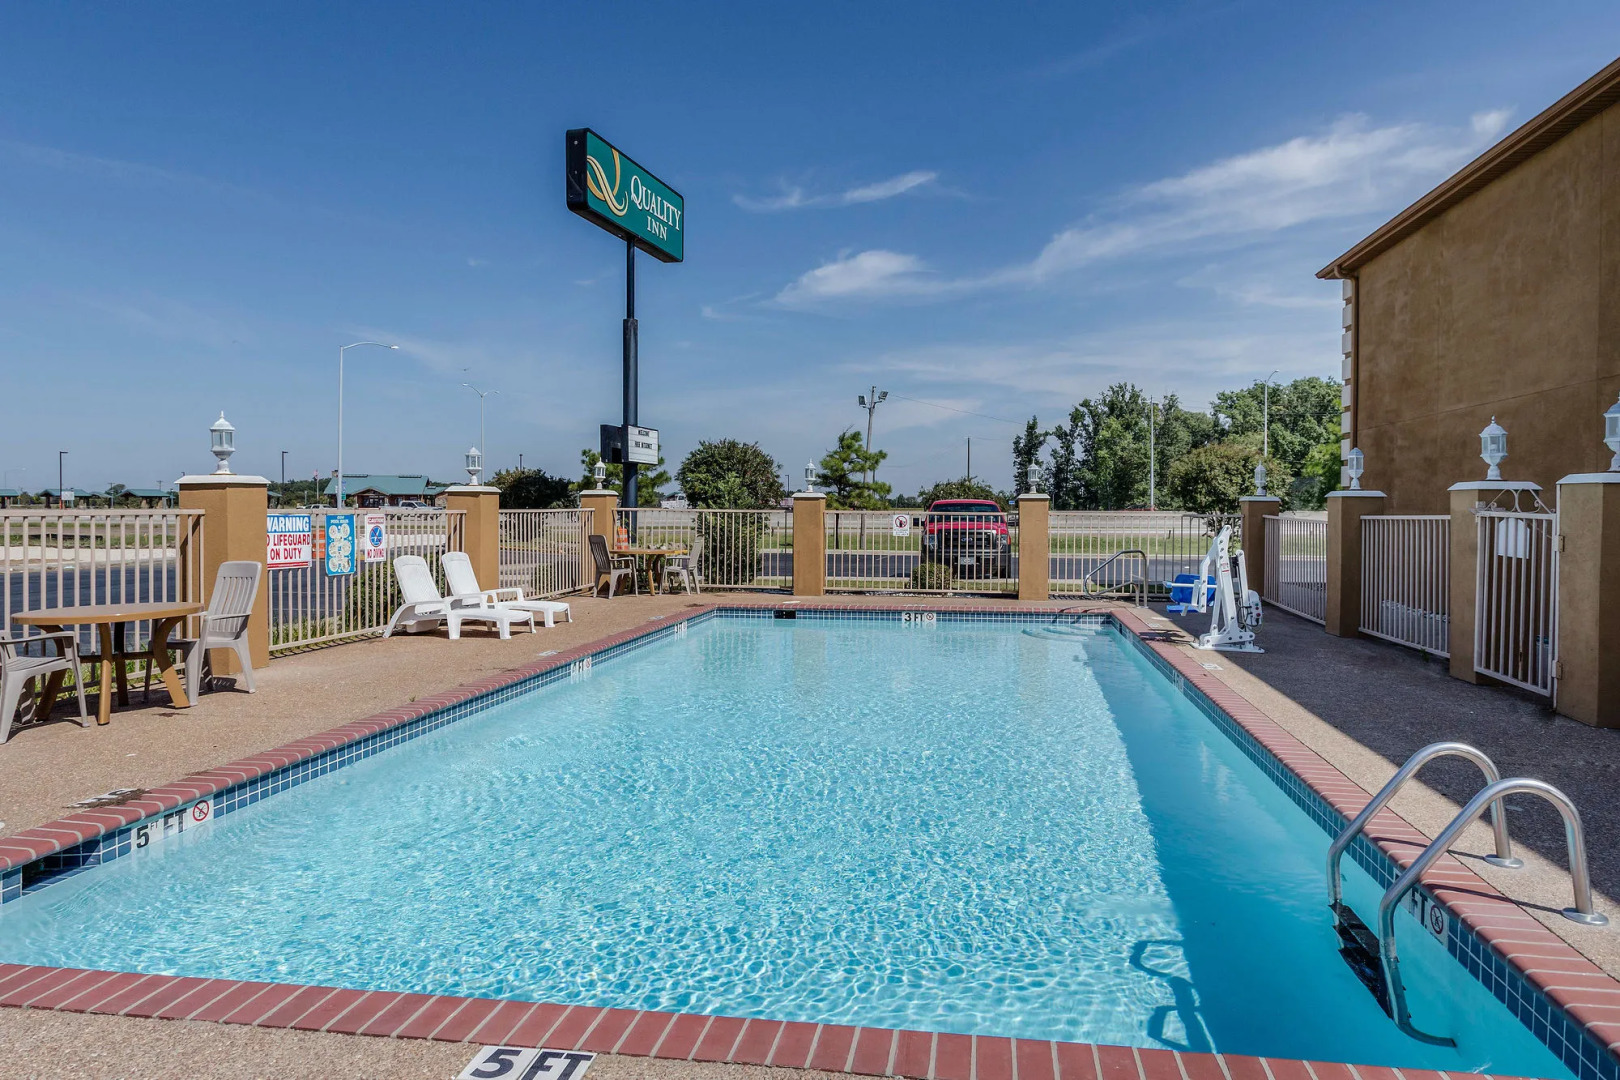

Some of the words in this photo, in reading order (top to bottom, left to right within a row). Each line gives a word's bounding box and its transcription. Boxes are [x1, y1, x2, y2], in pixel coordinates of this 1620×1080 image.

[630, 175, 681, 231] QUALITY
[647, 215, 668, 241] INN
[273, 533, 311, 547] LIFEGUARD
[270, 548, 281, 561] ON
[283, 547, 302, 560] DUTY
[904, 612, 912, 621] 3
[914, 612, 924, 621] FT
[136, 824, 150, 849] 5
[163, 807, 187, 834] FT
[470, 1048, 523, 1079] 5
[521, 1051, 594, 1080] FT
